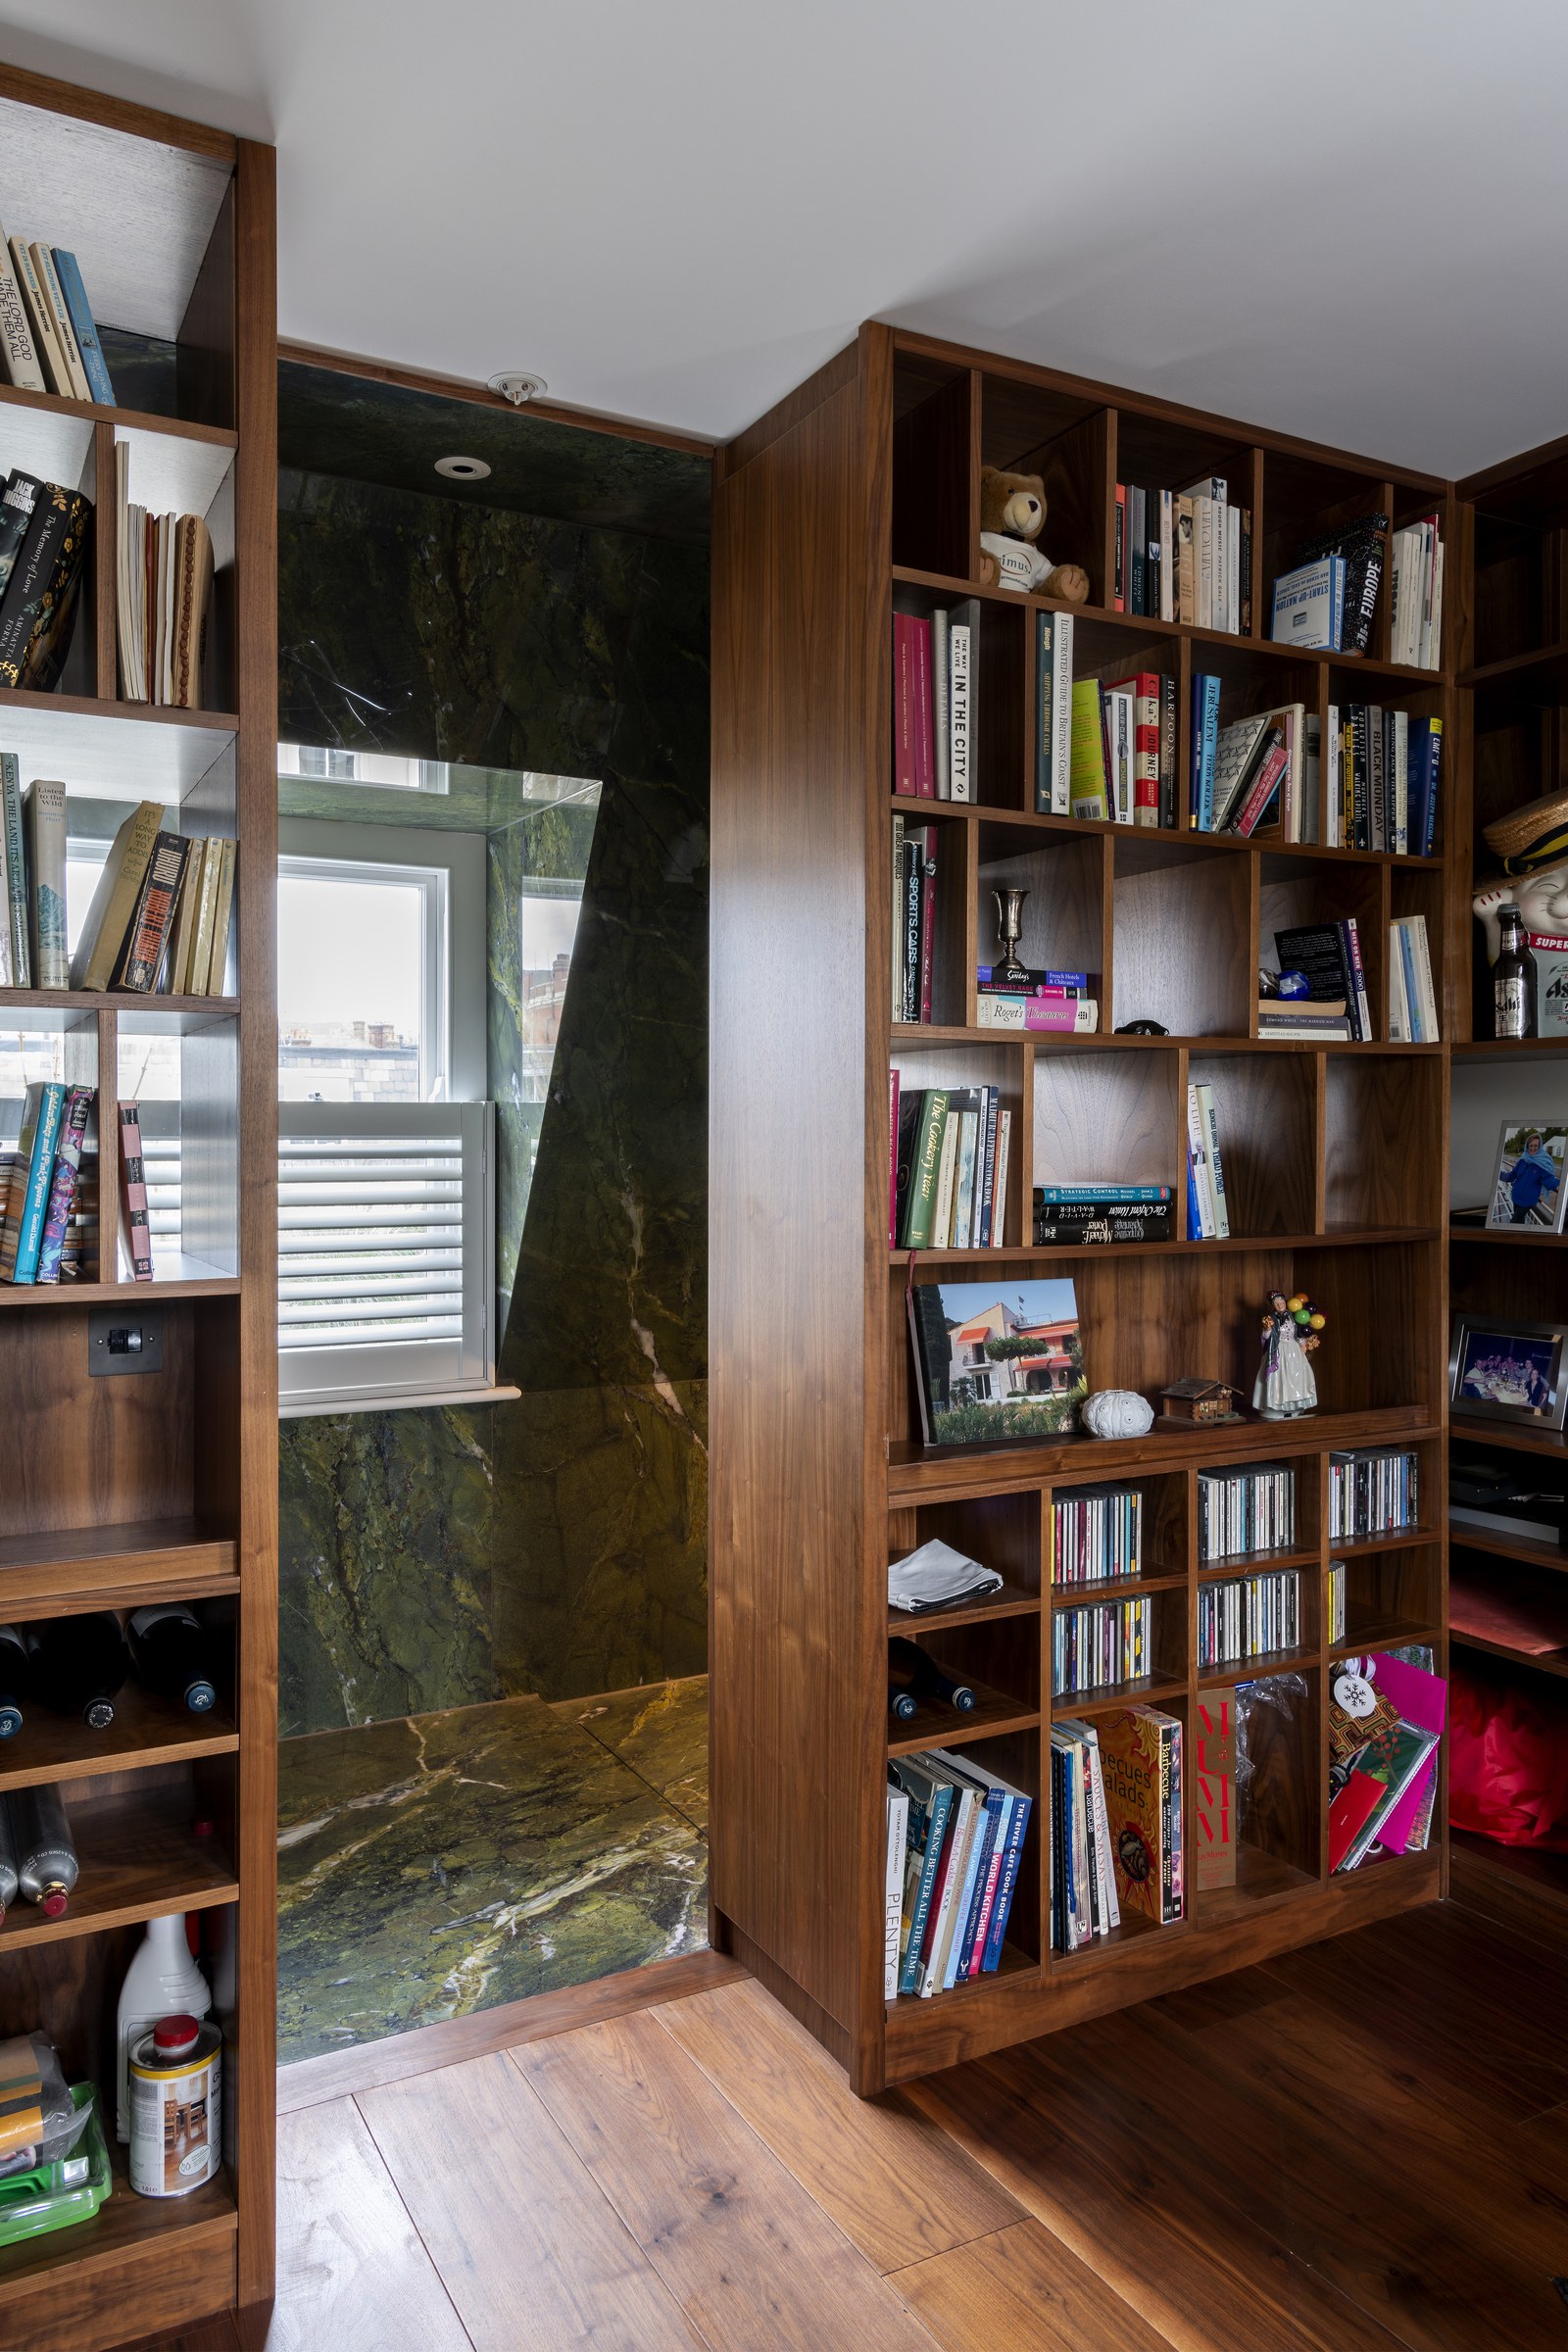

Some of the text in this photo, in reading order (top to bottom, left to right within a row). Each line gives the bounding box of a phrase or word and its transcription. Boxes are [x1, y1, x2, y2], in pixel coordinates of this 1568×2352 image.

[3, 278, 32, 361] THE LORD GOD
[3, 306, 16, 340] THEM
[32, 291, 51, 332] James Herriot
[60, 321, 76, 363] James Herriot
[3, 491, 36, 514] HIGGINS
[14, 478, 35, 498] JACK
[47, 514, 57, 528] The
[34, 526, 52, 564] Memory
[23, 573, 37, 594] Love
[1276, 585, 1329, 612] START-UP NATION
[1360, 561, 1382, 619] EUROPE
[6, 615, 24, 658] AMINATTA
[955, 639, 960, 651] WE
[940, 682, 949, 730] DETAILS
[1057, 619, 1070, 787] ILLUSTRATED GUIDE TO BRITAIN'S COAST
[1205, 684, 1217, 742] JERUSALEM
[955, 674, 966, 777] IN THE CITY
[1147, 679, 1157, 779] Cilka's JOURNEY
[1351, 715, 1360, 756] DAVIES
[38, 787, 66, 796] Listen
[1373, 730, 1384, 834] BLACK MONDAY
[6, 761, 21, 883] KENYA THE ART
[41, 800, 64, 808] Wild
[144, 809, 156, 819] IT'S
[135, 823, 156, 835] LONG
[135, 832, 153, 843] WAY
[135, 840, 147, 849] TO
[895, 822, 904, 831] 101
[126, 847, 149, 858] ADDIS
[152, 848, 183, 886] UHURU
[143, 887, 173, 929] ROBERT
[907, 877, 918, 964] SPORTS CARS
[133, 927, 163, 965] RUARK
[1007, 970, 1029, 983] Sawday's
[994, 1004, 1069, 1023] Roget's Thesaurus
[46, 1088, 60, 1117] Golden
[989, 1098, 998, 1130] MADHUR
[1189, 1086, 1201, 1137] TO LIFE!
[44, 1116, 56, 1138] Bats
[38, 1154, 49, 1179] Pink
[921, 1096, 947, 1201] The Cookery Year
[1208, 1108, 1217, 1131] KENICHI
[1215, 1174, 1225, 1196] POWER
[33, 1176, 48, 1208] Pigeons
[1107, 1204, 1167, 1216] The Oxford Union
[27, 1230, 36, 1252] Durrell
[1087, 1218, 1108, 1232] Porter
[1089, 1230, 1113, 1245] Michael
[1113, 1218, 1144, 1230] Advantage
[1113, 1228, 1145, 1242] Competitive
[1161, 1742, 1171, 1800] Barbecue
[1086, 1793, 1095, 1833] barbecue
[1093, 1768, 1105, 1882] SAUCES SALSAS
[959, 1811, 977, 1876] ILLUSTRATED GUIDE
[997, 1803, 1026, 1921] THE RIVER CAFE COOK BOOK
[954, 1823, 983, 1955] NIGELLA LAWSON FOREVER SUMMER
[978, 1864, 987, 1878] THE
[906, 1807, 947, 1978] COOKING BETTER ALL THE TIME
[977, 1853, 1001, 1942] WORLD KITCHEN
[885, 1892, 901, 1969] PLENTY
